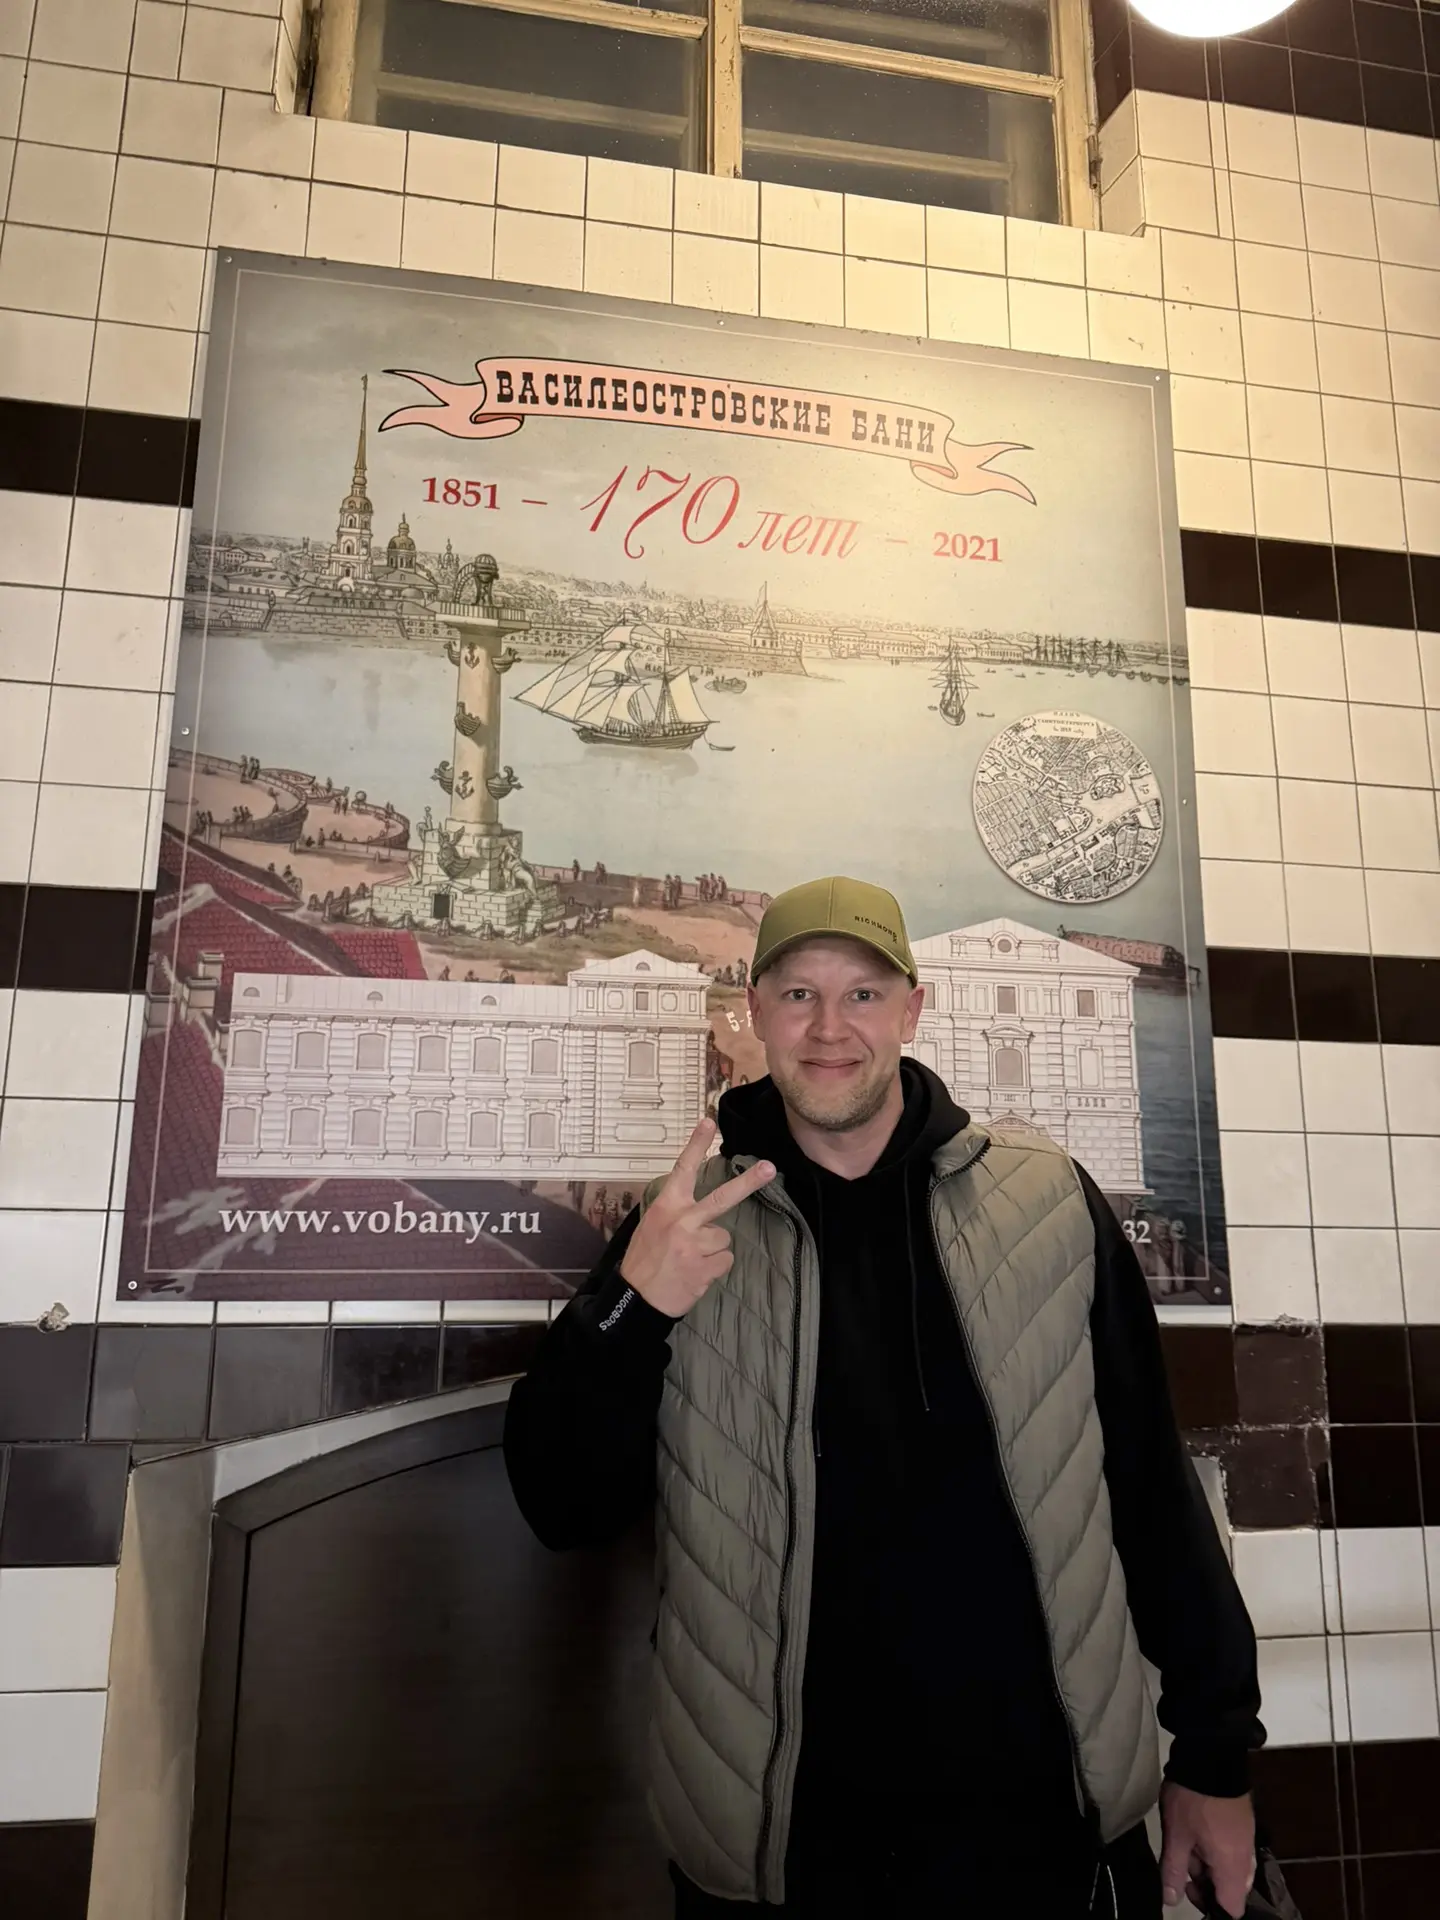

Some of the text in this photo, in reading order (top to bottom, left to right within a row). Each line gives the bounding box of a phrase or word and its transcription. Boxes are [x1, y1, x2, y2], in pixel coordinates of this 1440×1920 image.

[496, 370, 935, 453] ВАСИЛЕОСТРОВСКИЕ БАНИ
[422, 477, 501, 509] 1851
[580, 465, 740, 559] 170
[737, 511, 861, 559] лет
[933, 531, 1003, 562] 2021
[218, 1201, 541, 1244] www.vobany.ru
